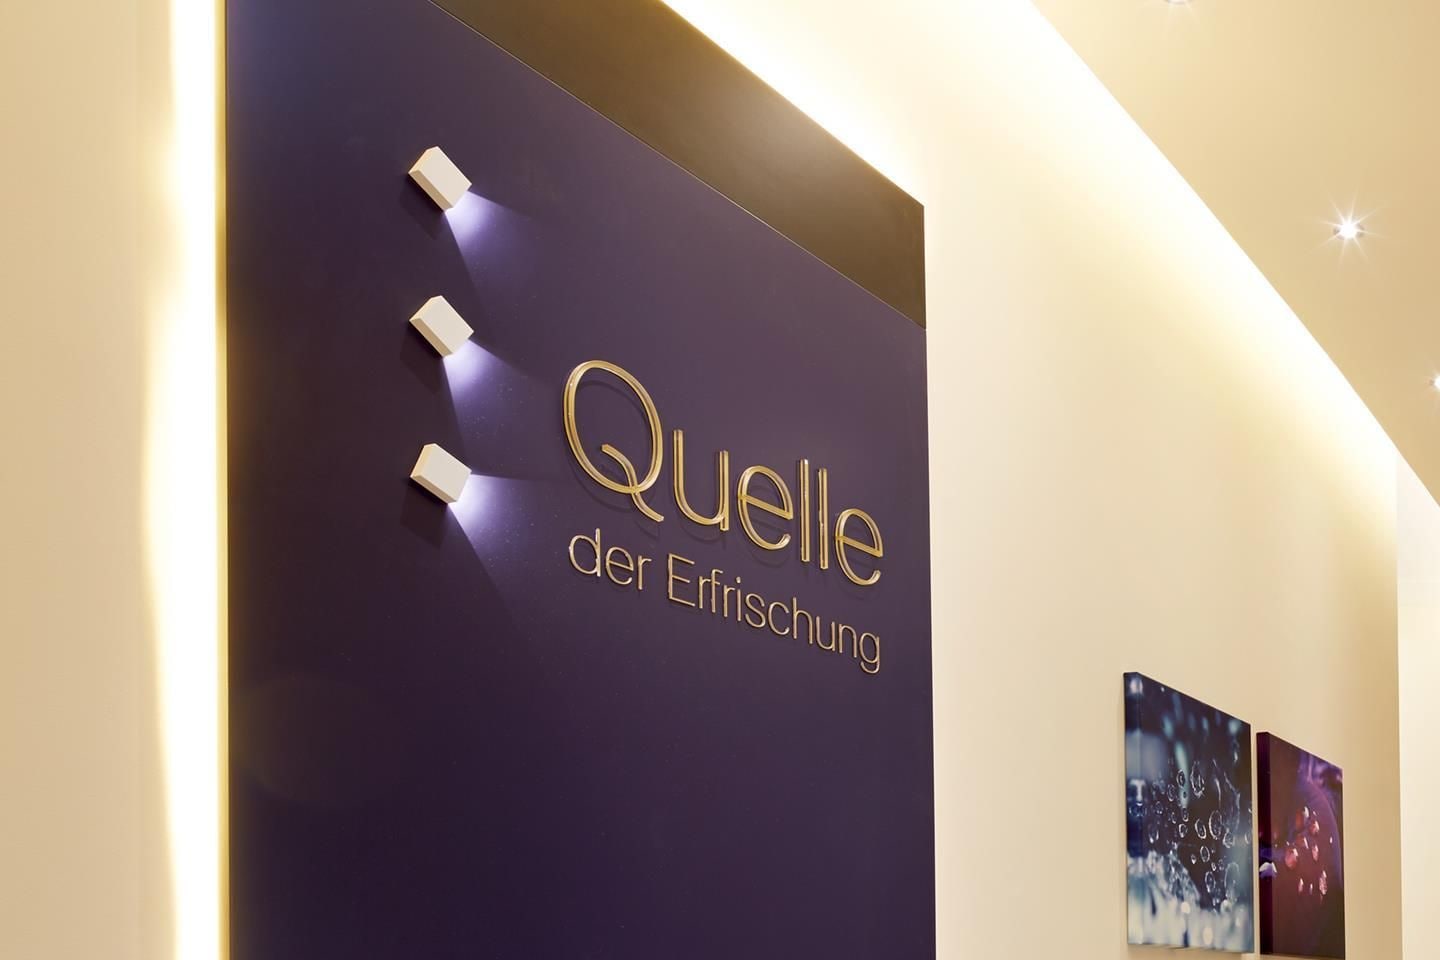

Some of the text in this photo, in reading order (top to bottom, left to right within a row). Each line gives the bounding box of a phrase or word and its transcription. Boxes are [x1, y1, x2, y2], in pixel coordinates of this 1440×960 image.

[563, 359, 884, 586] Quelle
[568, 528, 880, 674] der Erfrischung
